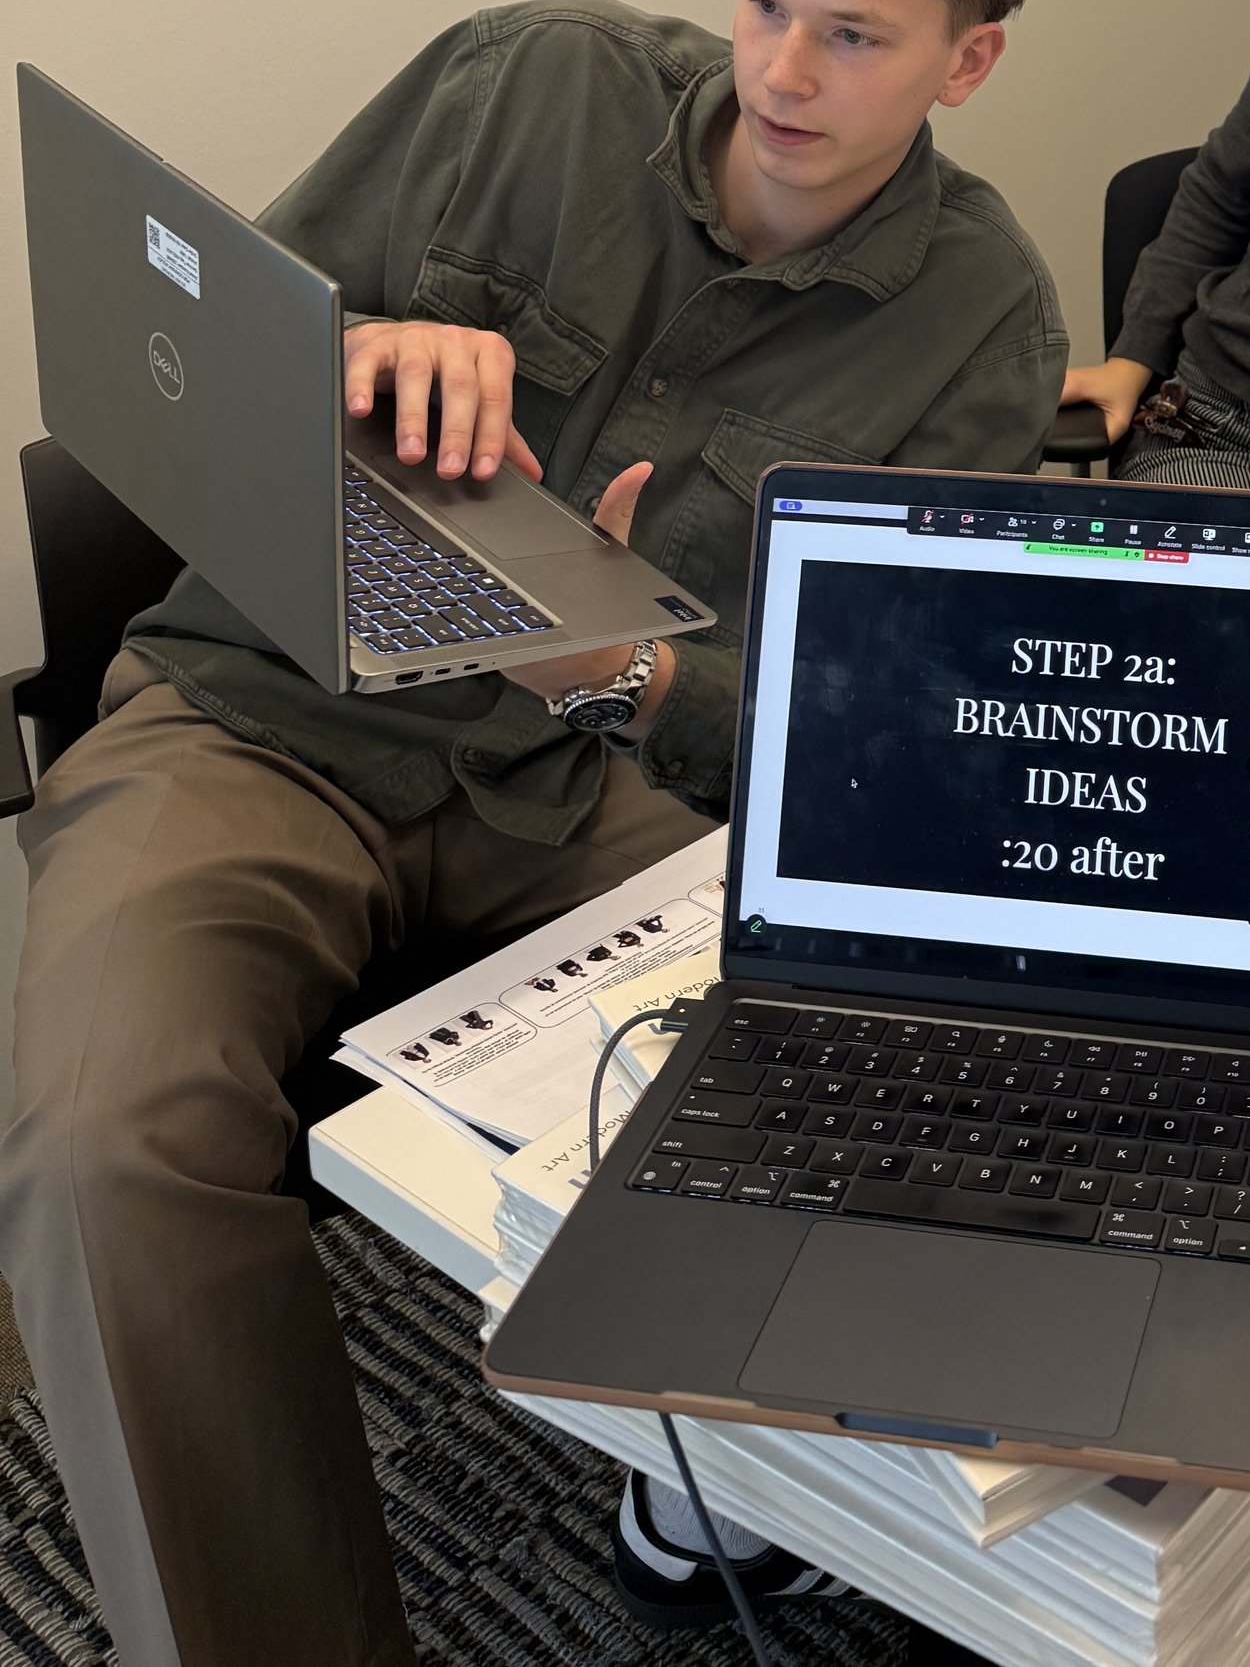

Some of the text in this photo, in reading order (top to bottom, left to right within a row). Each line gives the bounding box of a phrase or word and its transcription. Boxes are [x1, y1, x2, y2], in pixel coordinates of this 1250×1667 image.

[153, 350, 181, 384] DELL
[1012, 638, 1176, 685] STEP 2a:
[953, 698, 1228, 754] BRAINSTORM
[1024, 768, 1147, 813] IDEAS
[1002, 837, 1165, 880] :20 after
[633, 997, 660, 1011] Art
[682, 1109, 701, 1117] caps
[662, 1140, 683, 1149] shift
[542, 1154, 569, 1171] Art
[690, 1179, 722, 1189] control
[742, 1186, 771, 1195] option
[790, 1191, 833, 1202] command
[1108, 1230, 1153, 1240] command
[1173, 1237, 1203, 1246] option
